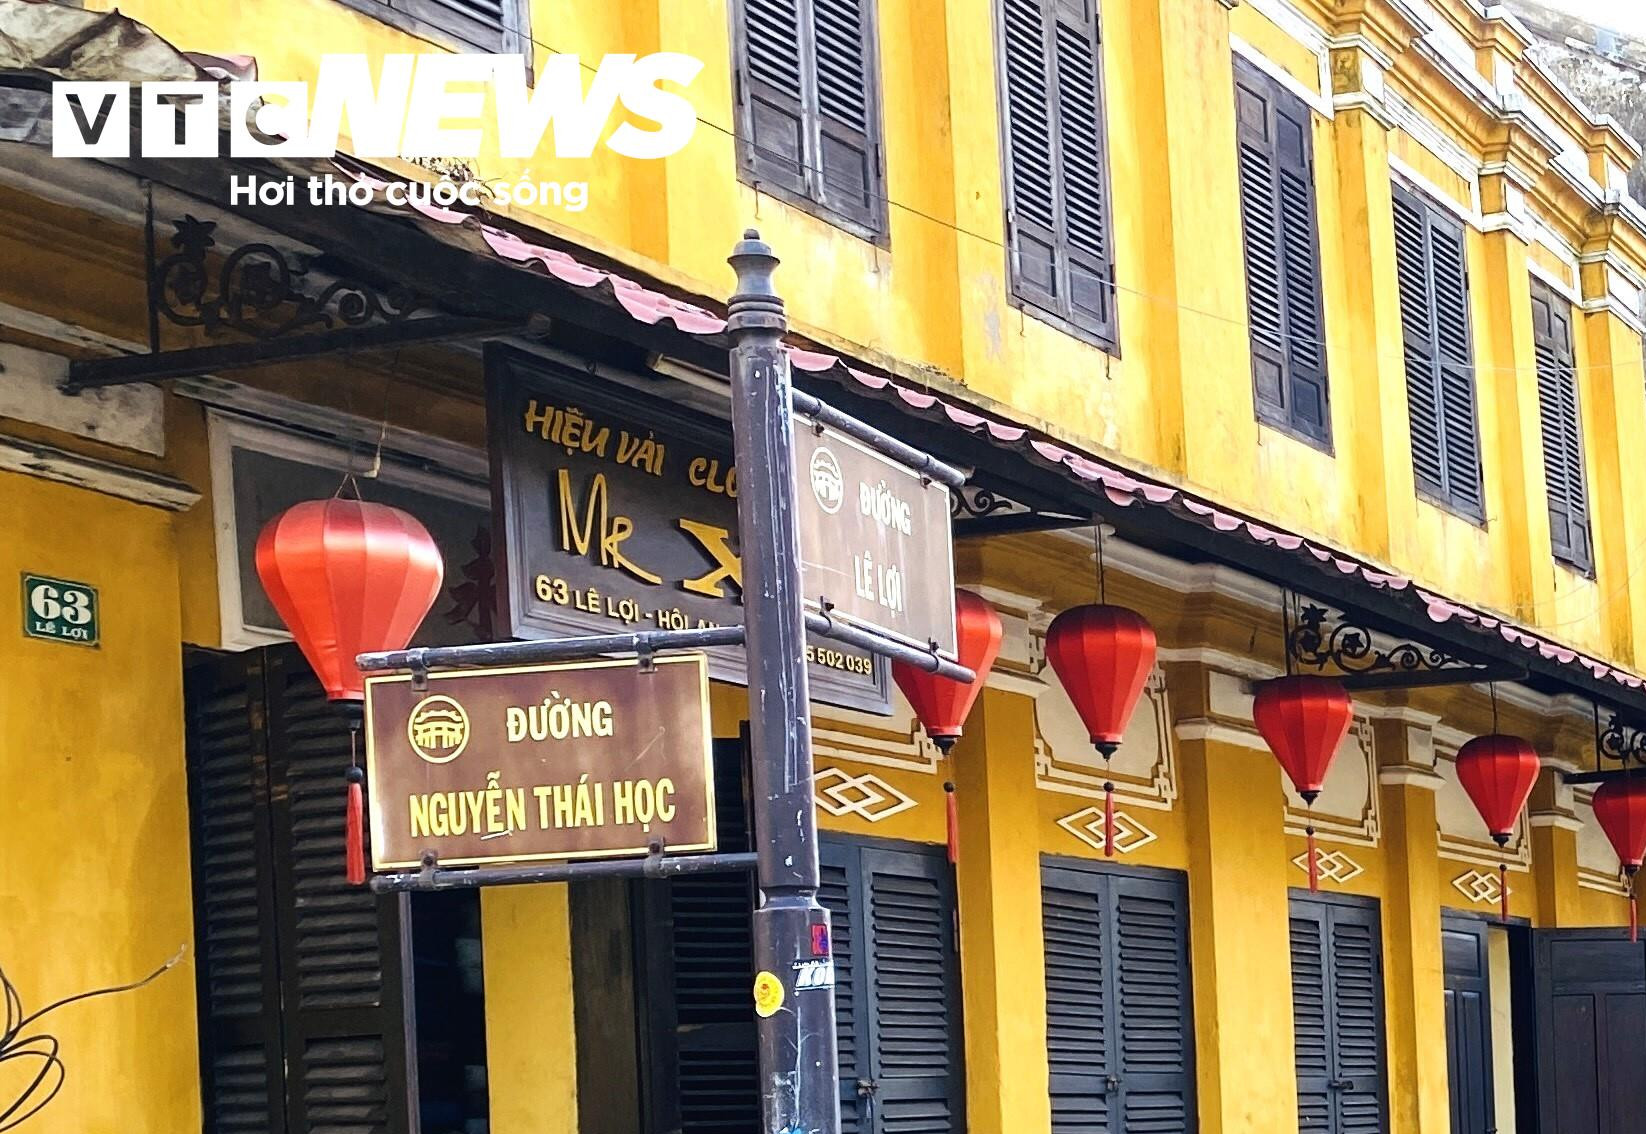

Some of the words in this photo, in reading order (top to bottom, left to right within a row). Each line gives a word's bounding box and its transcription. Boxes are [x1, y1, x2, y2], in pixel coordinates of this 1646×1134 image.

[616, 429, 665, 477] VẢI
[859, 478, 912, 536] ĐƯỜNG
[30, 584, 92, 625] 63
[853, 550, 875, 601] LÊ
[877, 564, 903, 618] LỢI
[35, 620, 57, 634] LÊ
[62, 625, 89, 640] LỢI
[534, 573, 570, 606] 63
[575, 587, 602, 614] LÊ
[607, 596, 640, 626] LỢI
[818, 647, 844, 670] 502
[846, 655, 873, 675] 039
[505, 690, 615, 743] ĐƯỜNG
[408, 770, 527, 838] NGUYỄN
[533, 773, 605, 830] THÁI
[612, 777, 676, 834] HỌC
